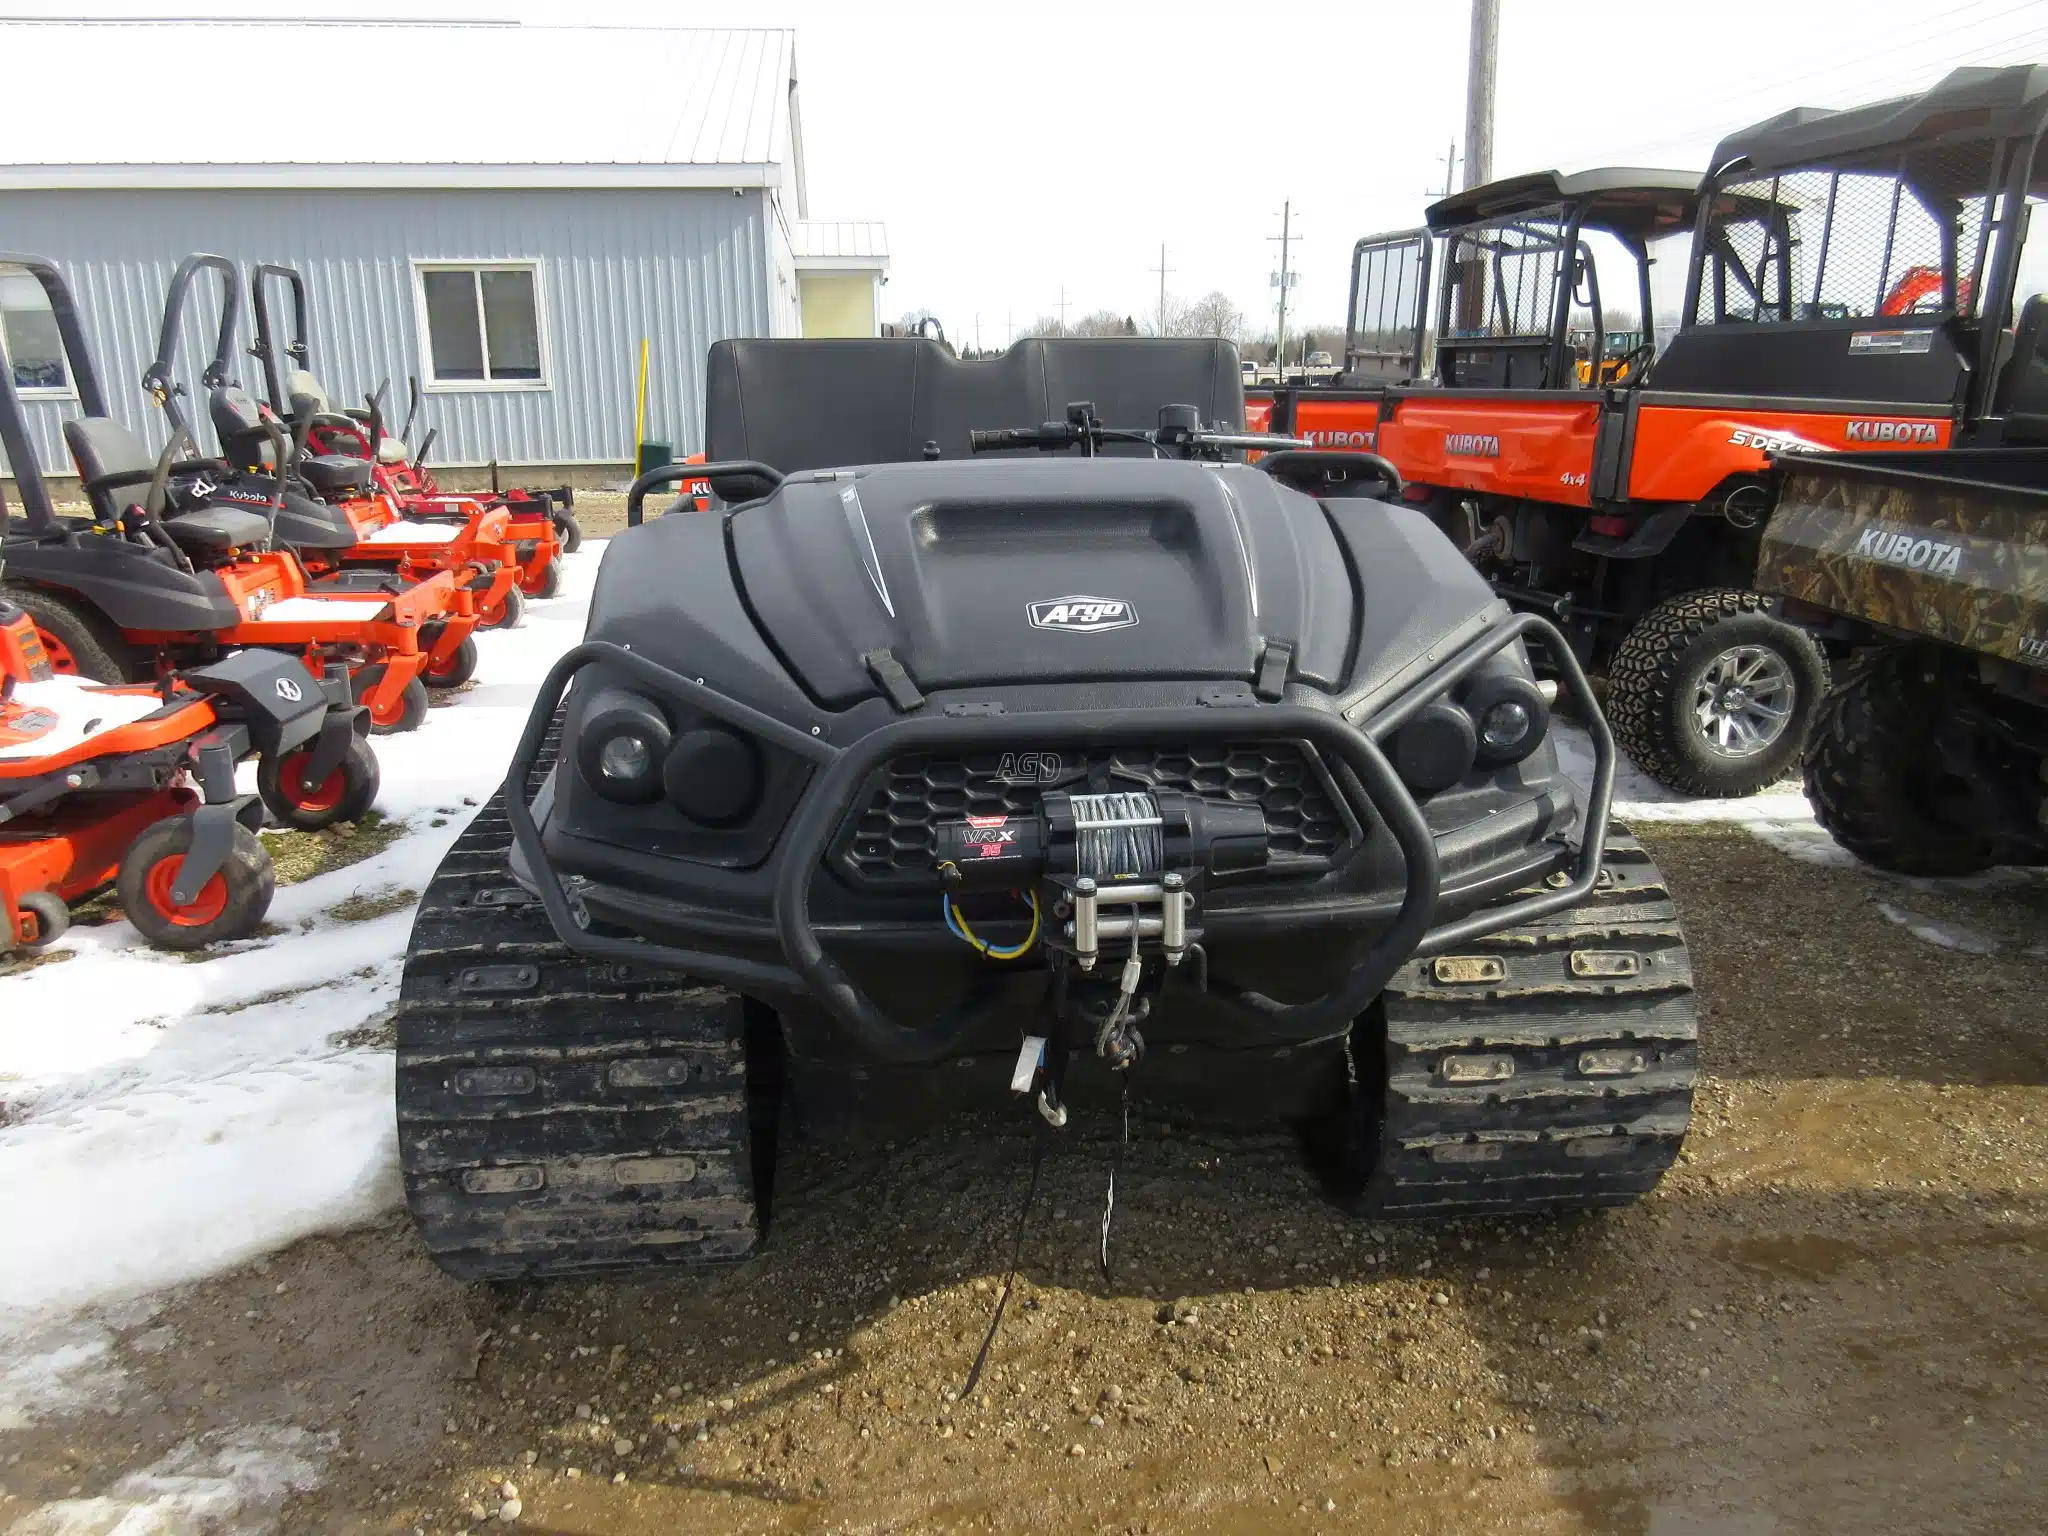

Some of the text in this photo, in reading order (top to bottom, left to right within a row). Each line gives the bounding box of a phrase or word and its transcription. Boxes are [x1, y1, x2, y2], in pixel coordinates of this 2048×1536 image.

[1303, 431, 1375, 448] KUBOT
[1845, 422, 1938, 443] KUBOTA
[1445, 434, 1499, 457] KUBOTA
[1560, 471, 1586, 487] 4x4
[230, 490, 267, 502] Kubota
[1854, 528, 1962, 577] KUBOTA
[1040, 604, 1124, 623] Argo
[962, 829, 1015, 844] VRX
[980, 843, 1002, 857] 35
